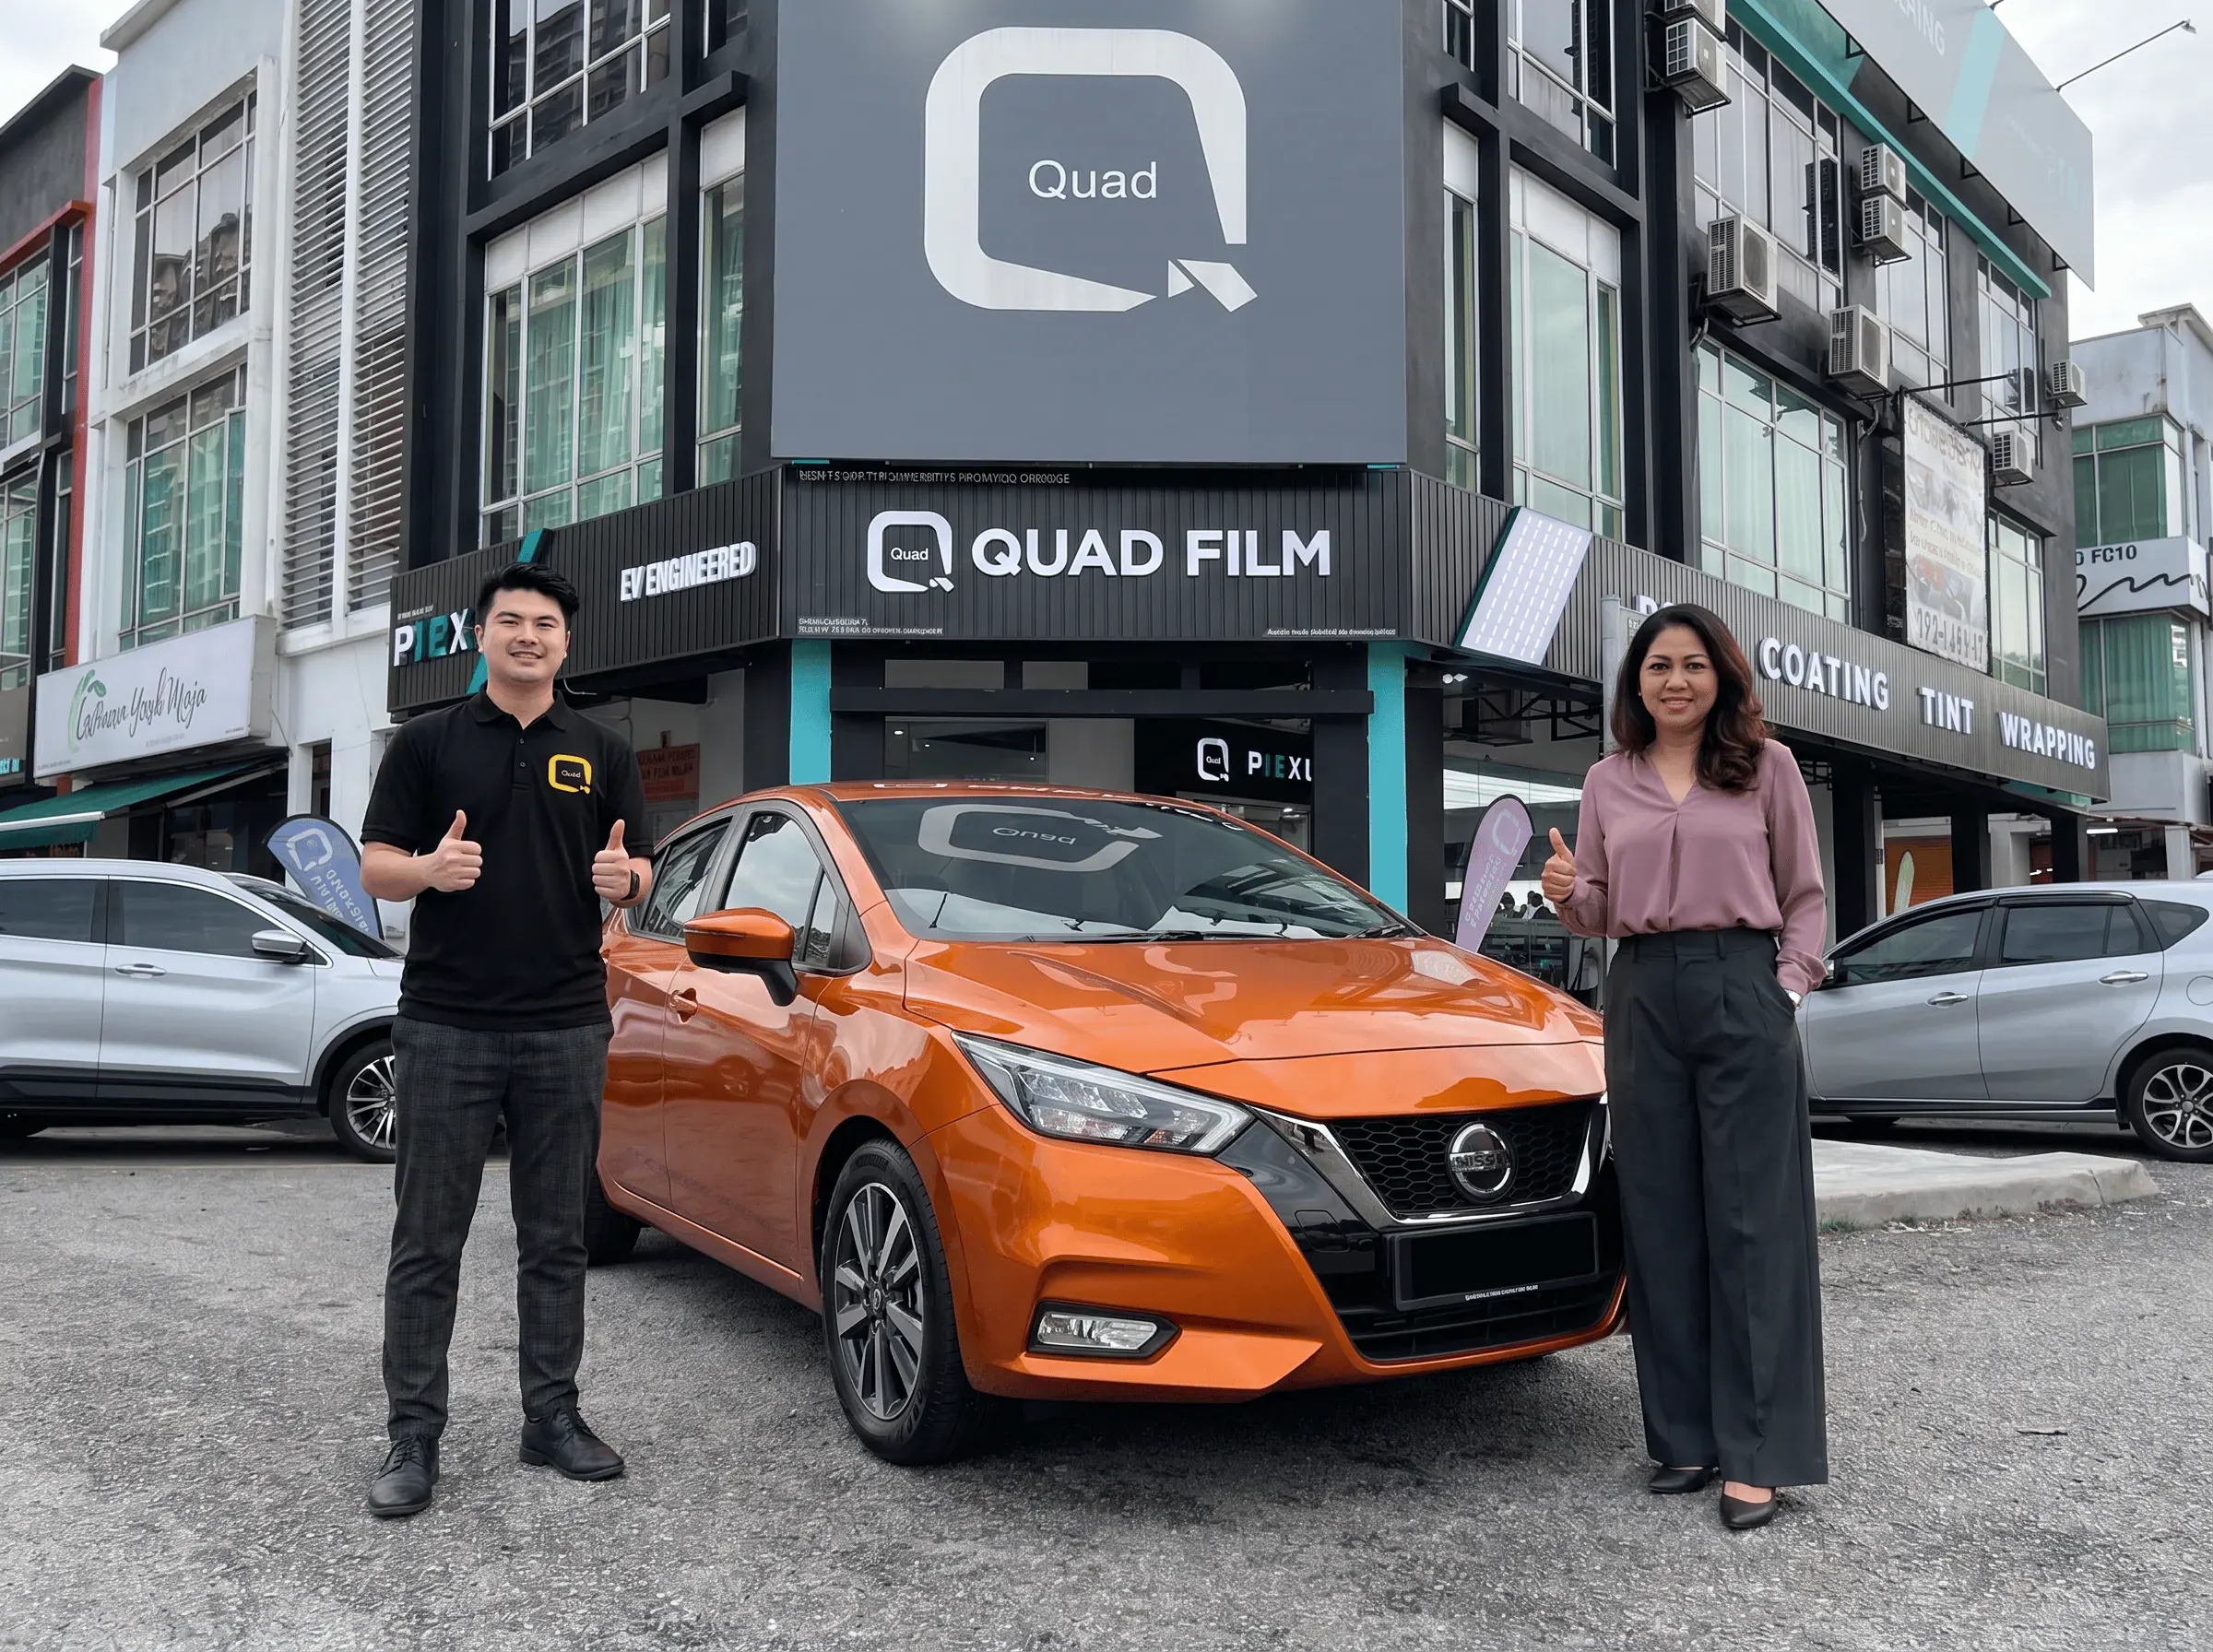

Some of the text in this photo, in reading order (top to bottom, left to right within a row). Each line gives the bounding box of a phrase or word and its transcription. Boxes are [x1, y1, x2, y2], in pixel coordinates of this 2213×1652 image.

[1028, 159, 1157, 201] Quad
[621, 540, 757, 602] EV ENGINEERED
[890, 547, 929, 560] Quad
[971, 527, 1331, 577] QUAD FILM
[2091, 544, 2137, 564] FC10
[1759, 637, 2096, 771] COATING TINT WRAPPING
